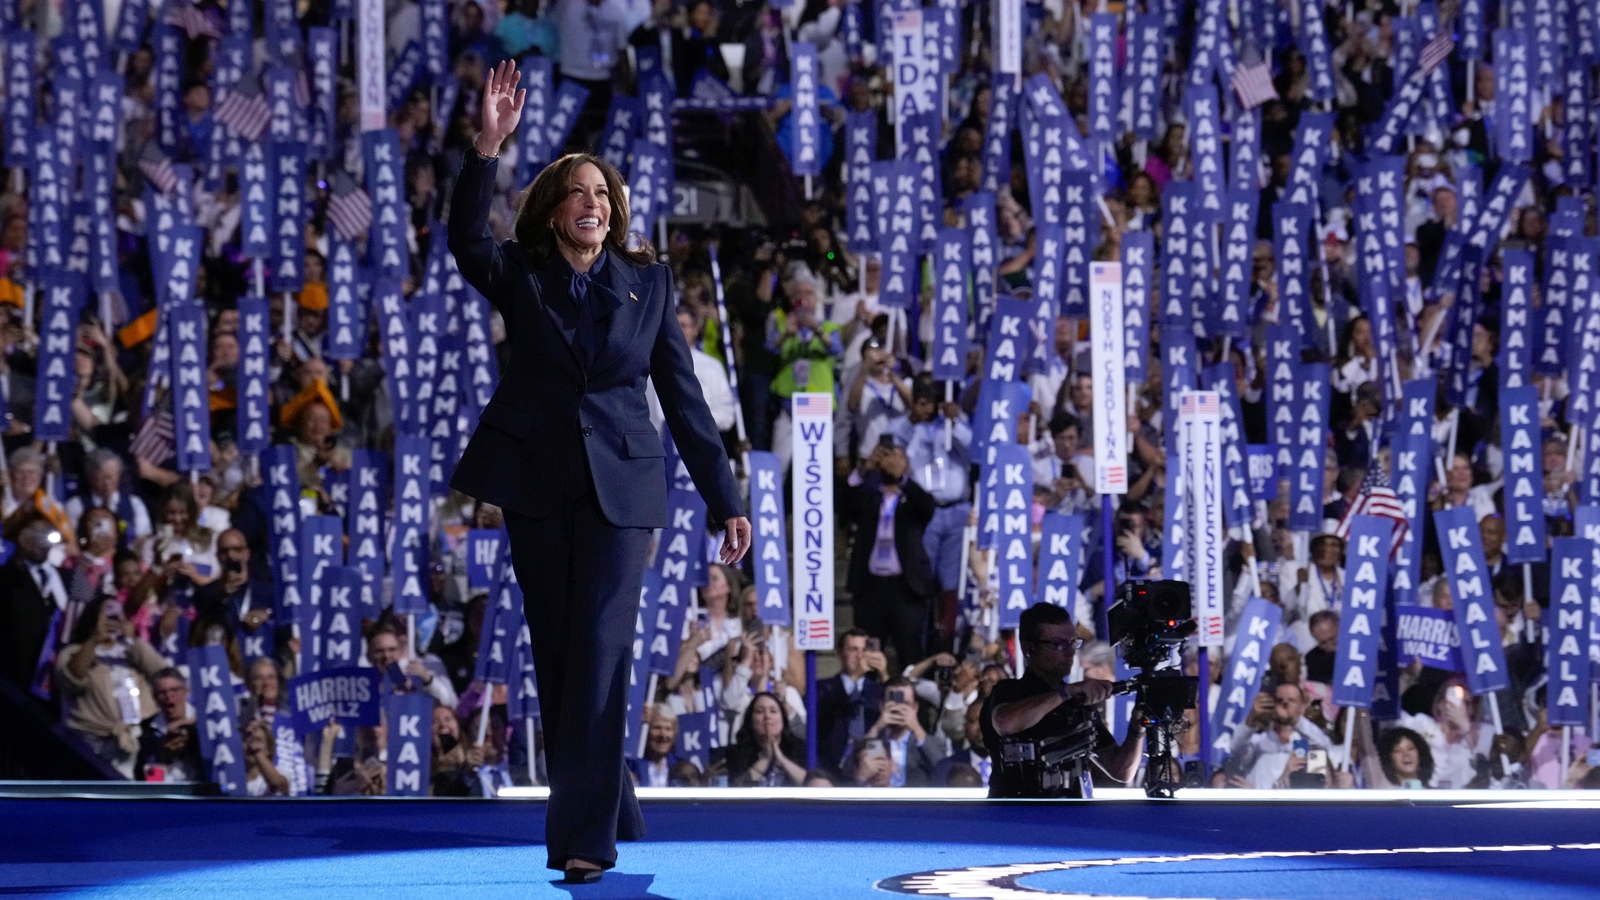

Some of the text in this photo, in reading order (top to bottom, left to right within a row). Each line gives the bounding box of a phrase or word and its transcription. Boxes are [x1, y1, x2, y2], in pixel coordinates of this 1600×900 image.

[525, 70, 546, 164] KAMAL
[547, 94, 577, 147] KAM
[797, 54, 815, 162] KAMALA
[900, 34, 919, 116] IDA
[1093, 25, 1114, 131] KAMALA
[1138, 25, 1160, 128] KAMALA
[1509, 43, 1527, 149] KAMALA
[1567, 71, 1586, 176] KAMALA
[244, 143, 265, 245] AMALA
[603, 110, 632, 166] KAM
[853, 127, 871, 241] KAMALA
[1043, 127, 1063, 223] KAMAL
[1194, 99, 1220, 210] KAMALA
[1291, 127, 1321, 205] KAMA
[36, 141, 61, 265] KAMALA
[278, 156, 301, 279] KAMALA
[375, 143, 401, 266] KAMALA
[887, 174, 915, 294] KAMALA
[1065, 185, 1086, 305] KAMALA
[1166, 195, 1188, 316] KAMALA
[1222, 202, 1249, 322] KAMALA
[1470, 175, 1518, 247] KAMA
[44, 286, 71, 424] KAMALA
[463, 300, 491, 405] KAMAL
[941, 241, 963, 365] KAMALA
[990, 314, 1021, 383] KAM
[1122, 246, 1147, 368] KAMALA
[1506, 265, 1528, 388] KAMALA
[1541, 249, 1569, 364] KAMALA
[178, 320, 204, 453] KAMALA
[245, 313, 265, 440] KAMALA
[430, 351, 461, 482] KAMALA
[1102, 289, 1117, 461] NORTH CAROLINA
[1273, 340, 1294, 465] KAMALA
[1297, 380, 1321, 514] KAMALA
[1508, 404, 1537, 545] KAMALA
[270, 463, 302, 606] KAMALA
[356, 467, 378, 605] KAMALA
[401, 454, 426, 597] KAMALA
[757, 468, 784, 609] KAMALA
[800, 422, 827, 613] WISCONSIN
[1003, 462, 1028, 610] KAMALA
[1045, 533, 1071, 608] KAM
[1203, 421, 1217, 609] TENNESSEE
[650, 506, 694, 656] KAMALA
[1342, 535, 1381, 688] KAMALA
[1396, 615, 1461, 648] HARRIS
[1447, 526, 1499, 676] KAMALA
[1557, 558, 1584, 707] KAMALA
[295, 676, 371, 712] HARRIS
[1212, 613, 1270, 753] KAMALA
[1402, 641, 1451, 662] WALZ
[200, 664, 237, 790] KAMAL
[308, 701, 360, 725] WALZ
[394, 714, 421, 792] KAM
